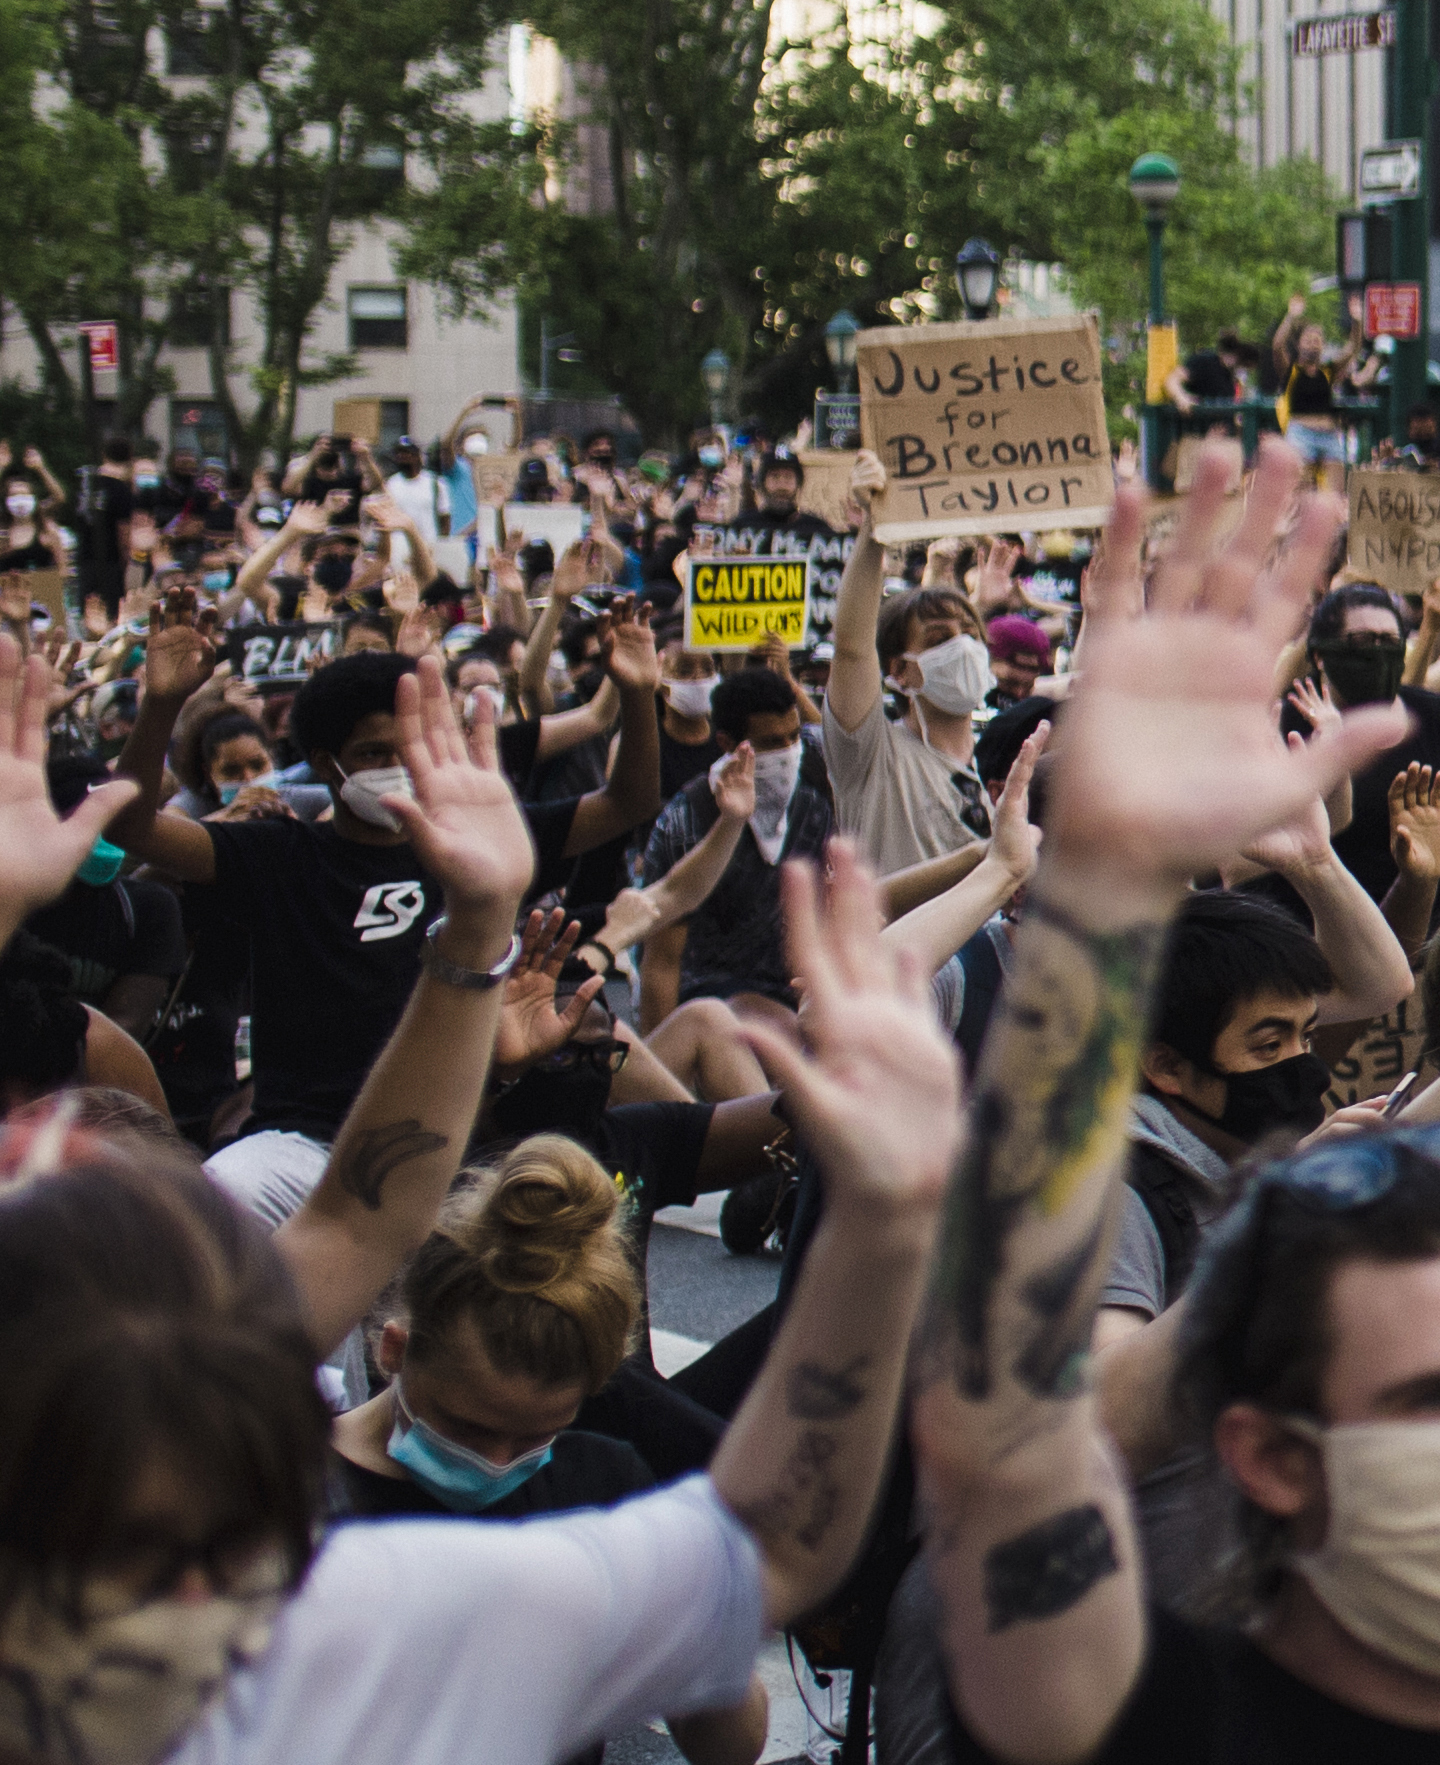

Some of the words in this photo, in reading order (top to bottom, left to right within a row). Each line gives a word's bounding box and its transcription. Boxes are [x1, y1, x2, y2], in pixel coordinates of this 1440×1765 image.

[1298, 16, 1370, 53] LAFAYETTE
[874, 350, 1090, 397] Justice
[936, 401, 1010, 436] for
[886, 433, 1100, 479] Breonna
[900, 477, 1083, 518] Taylor
[696, 565, 802, 601] CAUTION
[698, 609, 758, 638] WILD
[243, 629, 334, 678] BLM
